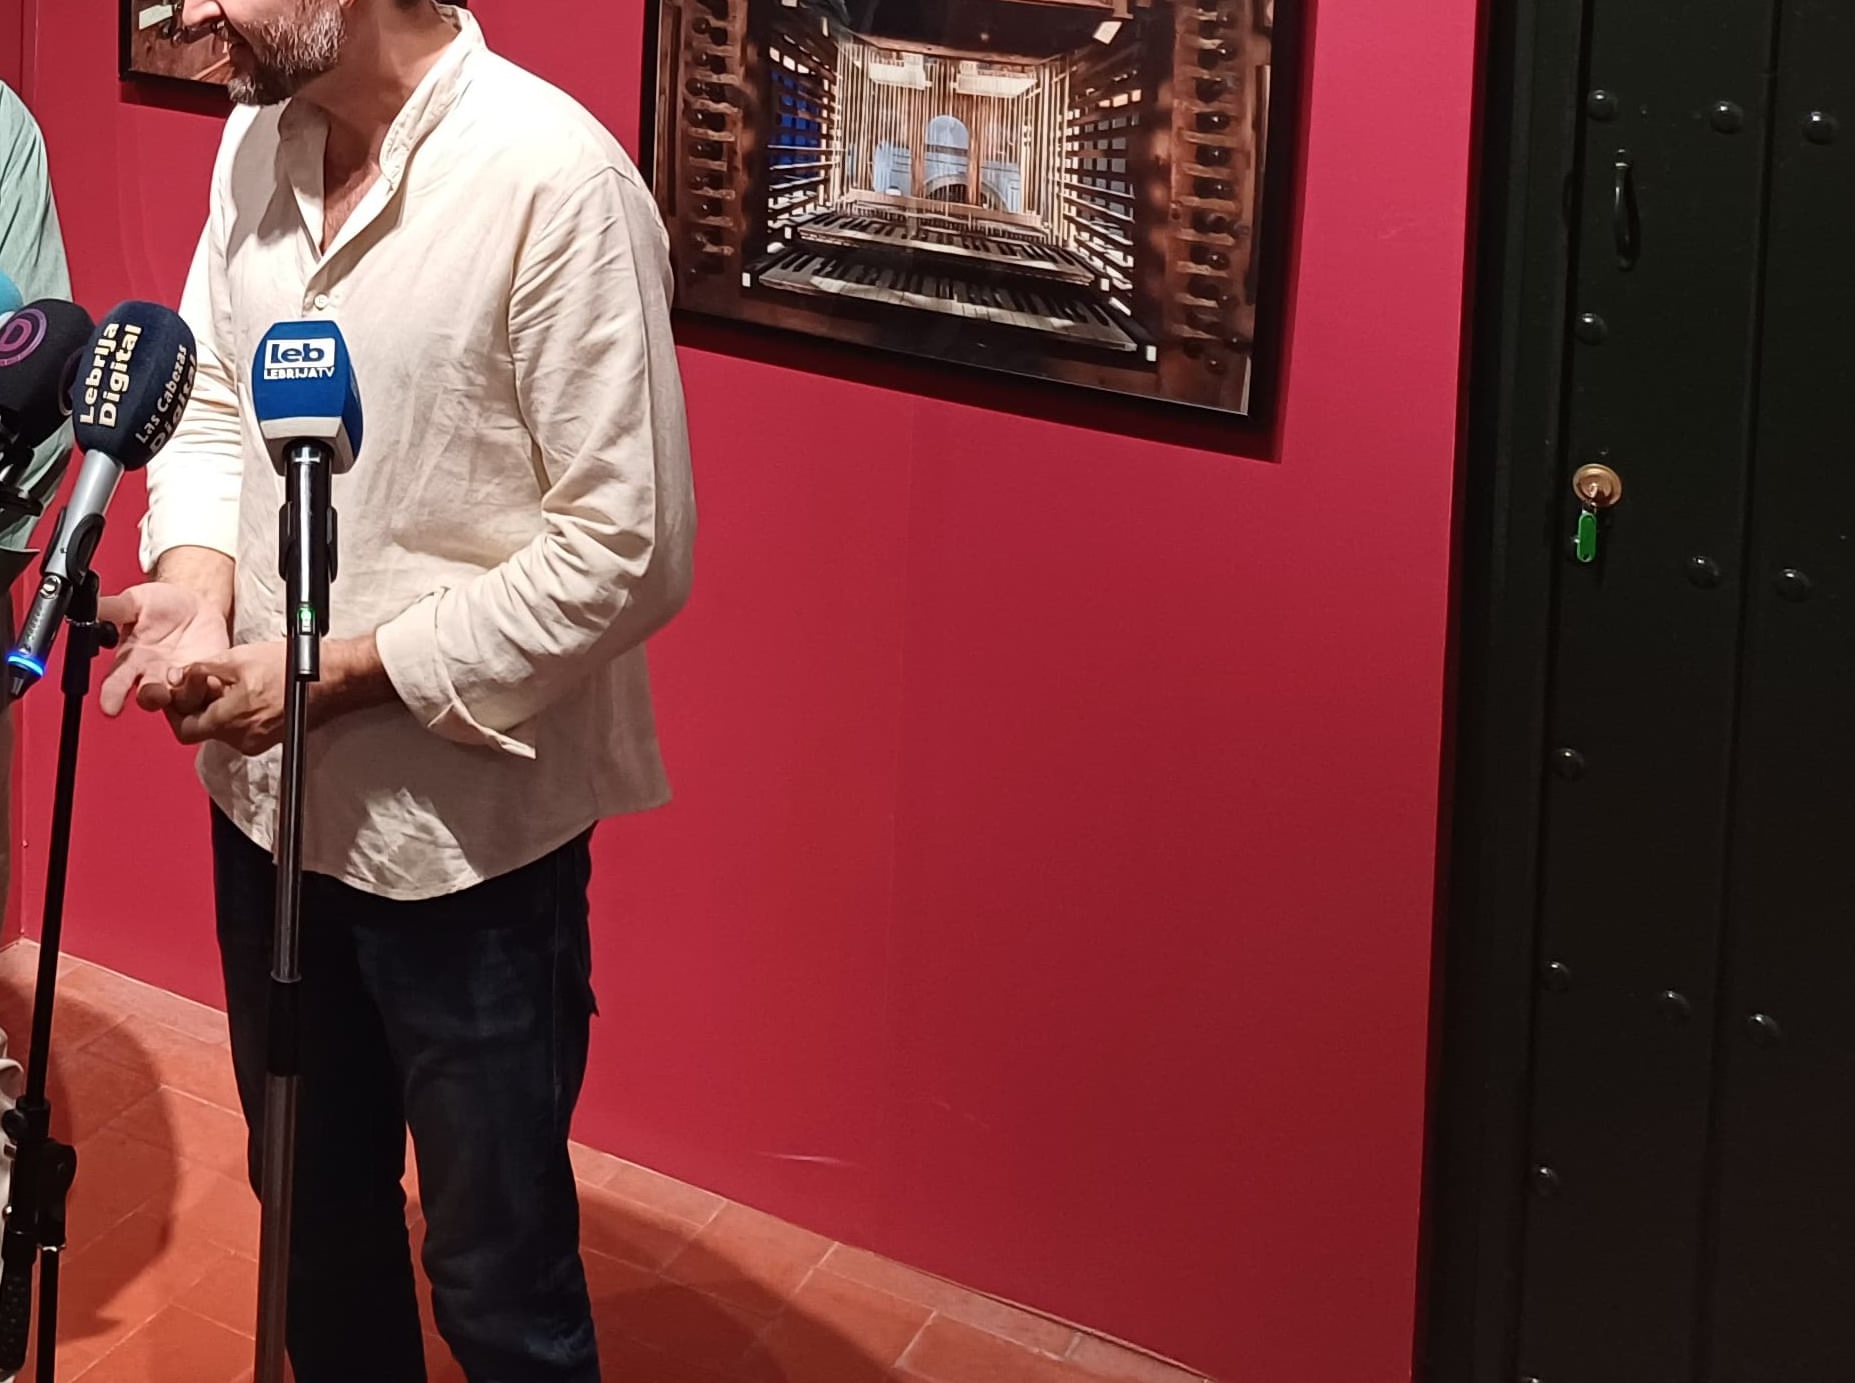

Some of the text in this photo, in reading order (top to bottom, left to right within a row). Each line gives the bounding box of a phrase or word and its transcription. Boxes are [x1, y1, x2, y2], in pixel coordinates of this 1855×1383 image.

[99, 324, 142, 428] Digital
[263, 367, 335, 380] LEBRIJATV
[270, 342, 325, 364] leb
[135, 344, 187, 445] Las Cabezas
